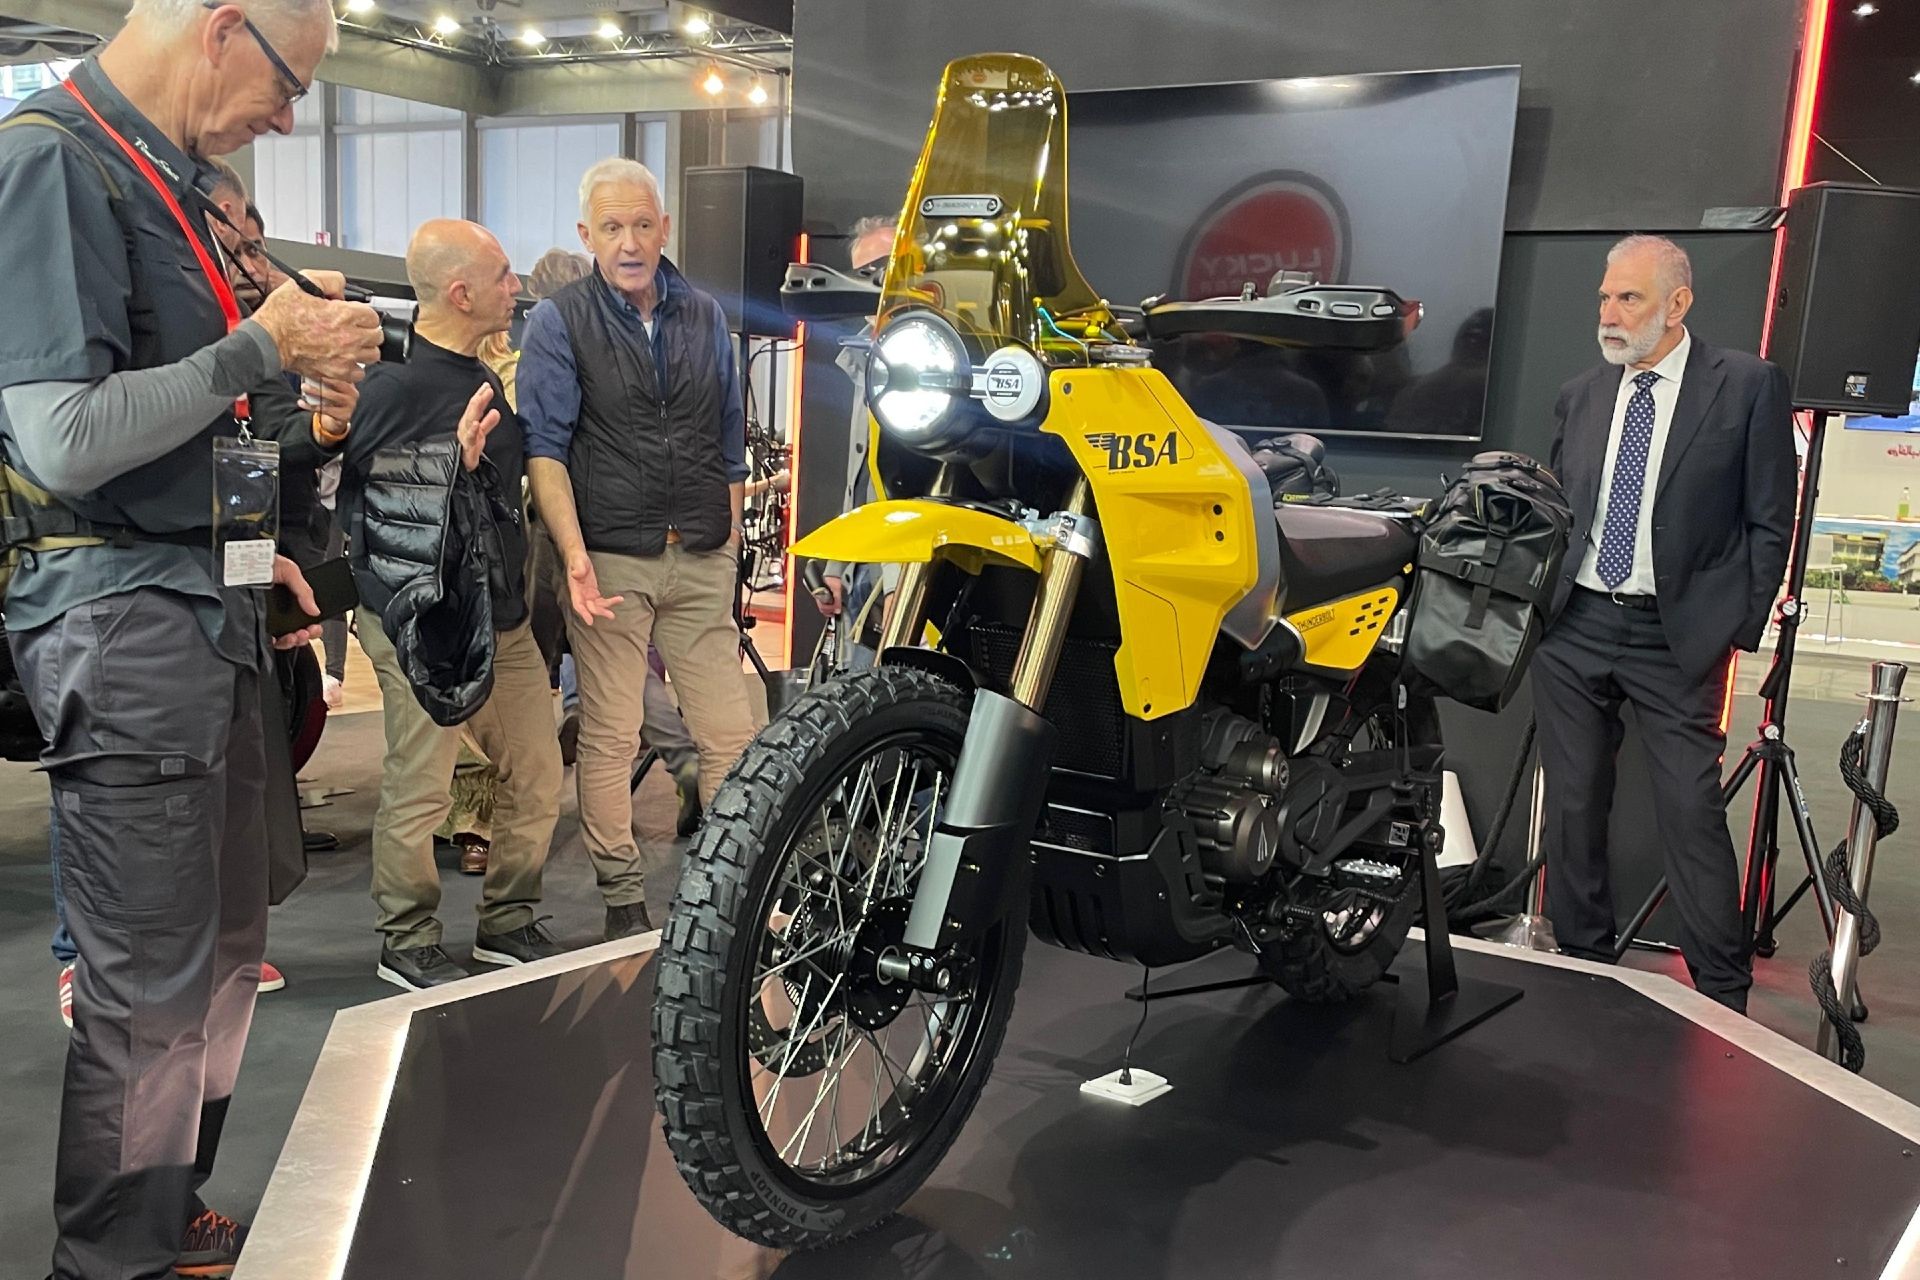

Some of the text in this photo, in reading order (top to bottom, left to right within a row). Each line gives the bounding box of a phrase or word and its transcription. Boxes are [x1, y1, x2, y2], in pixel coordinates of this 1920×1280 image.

[996, 377, 1020, 390] BSA
[1108, 431, 1178, 470] BSA
[750, 1171, 798, 1219] DUNLOP
